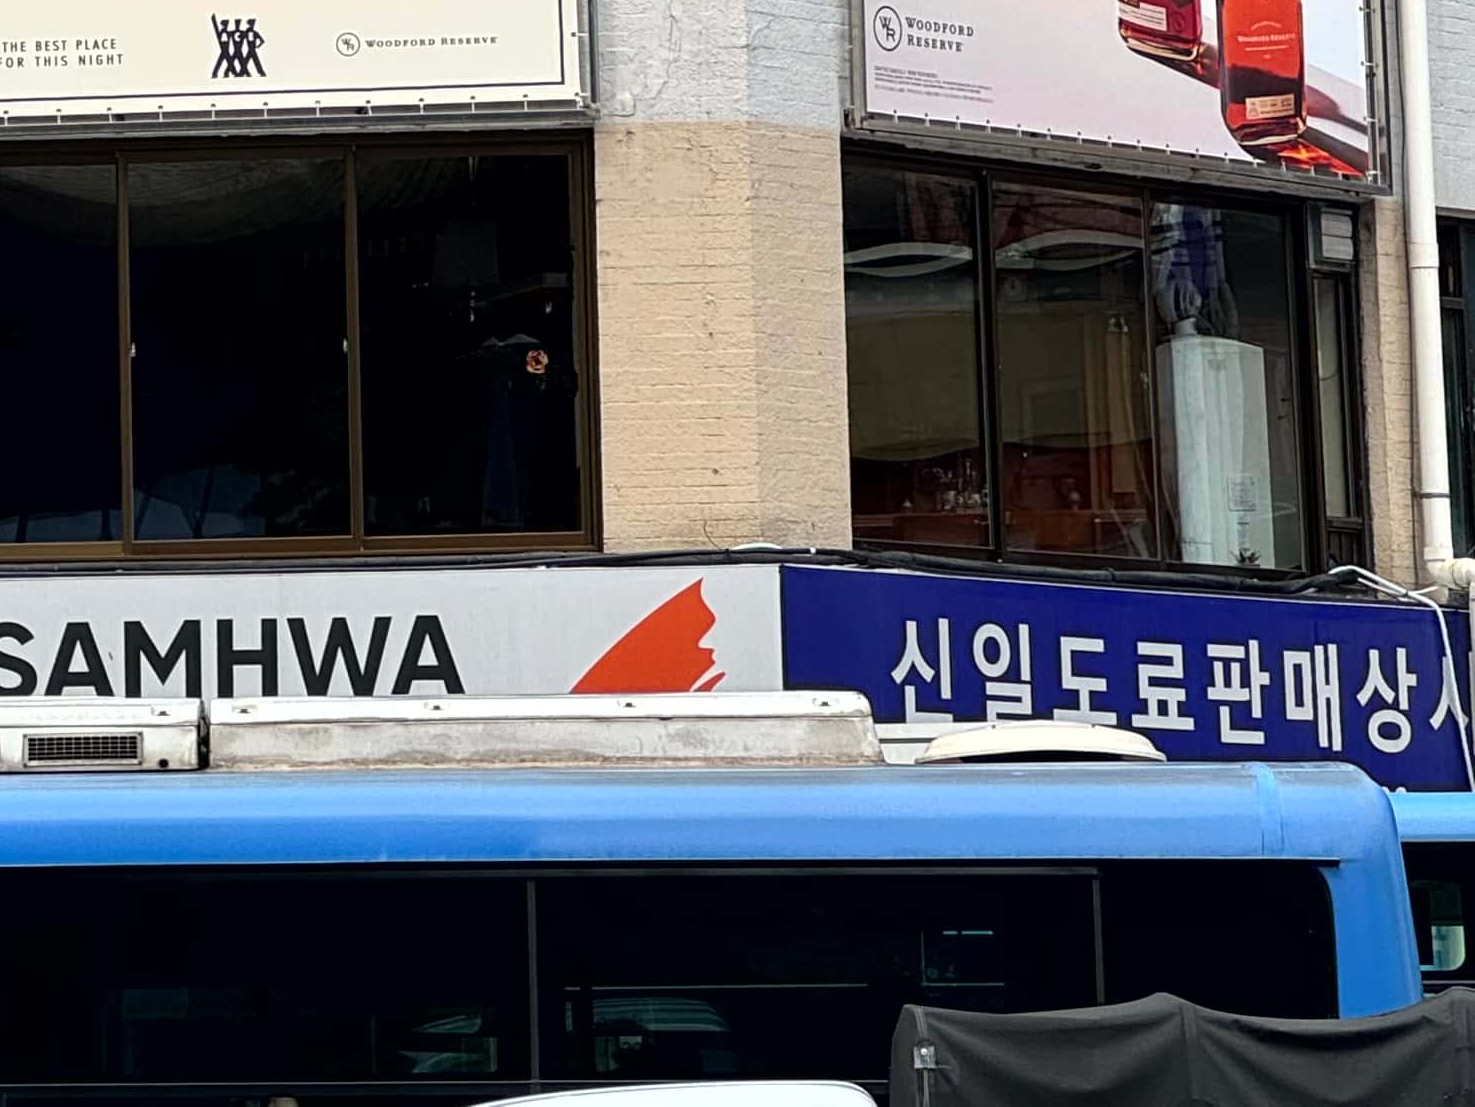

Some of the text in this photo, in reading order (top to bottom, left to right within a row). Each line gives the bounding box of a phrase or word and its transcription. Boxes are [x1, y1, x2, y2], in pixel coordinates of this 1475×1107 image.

[903, 15, 977, 40] WOODFORD
[1, 38, 118, 53] THE BEST PLACE
[905, 31, 966, 55] RESERVE
[34, 55, 68, 68] THIS
[77, 53, 124, 67] NIGHT
